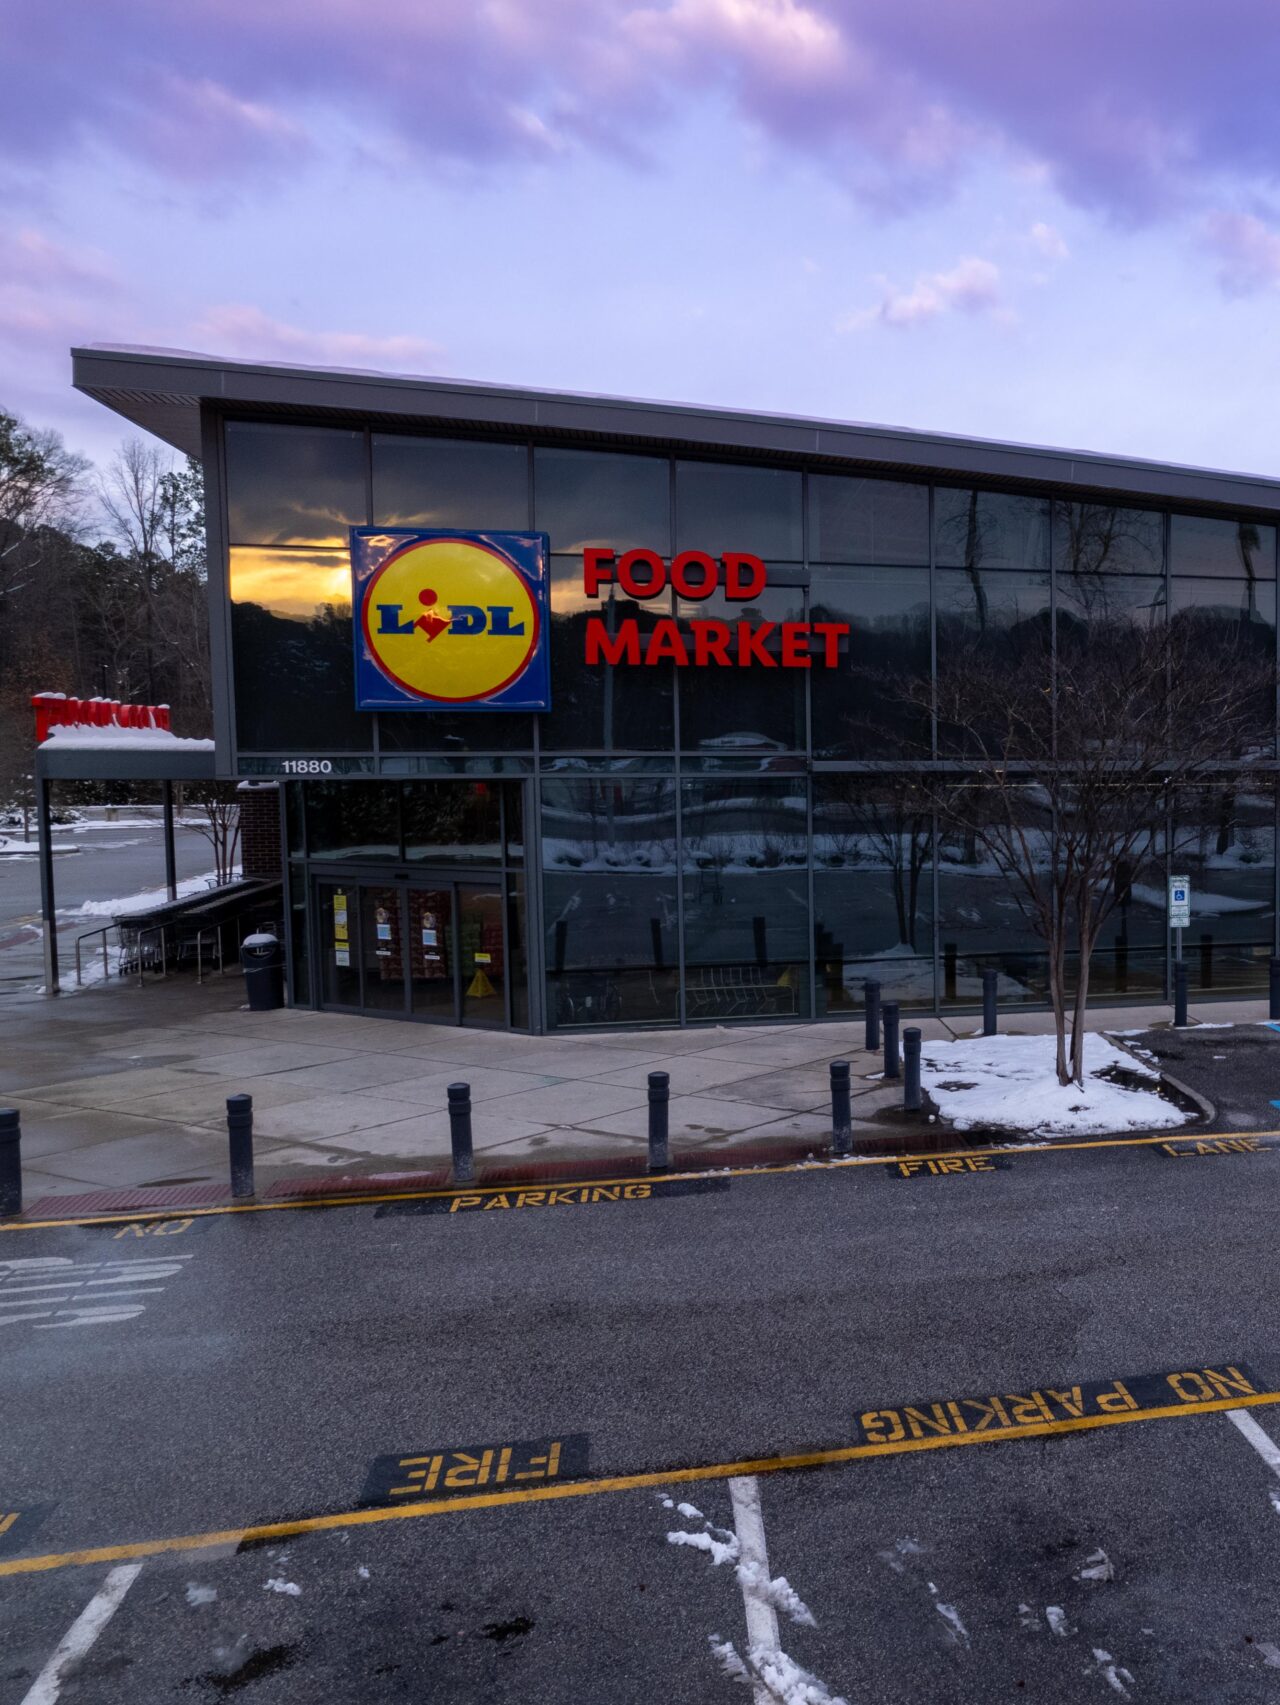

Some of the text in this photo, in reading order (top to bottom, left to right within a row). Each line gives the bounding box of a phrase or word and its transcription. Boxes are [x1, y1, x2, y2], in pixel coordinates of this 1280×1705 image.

[583, 547, 767, 602] FOOD
[584, 617, 849, 668] MARKET
[282, 760, 332, 774] 11880
[112, 1138, 1273, 1240] NO PARKING FIRE LANE
[389, 1366, 1257, 1495] NO PARKING FIRE
